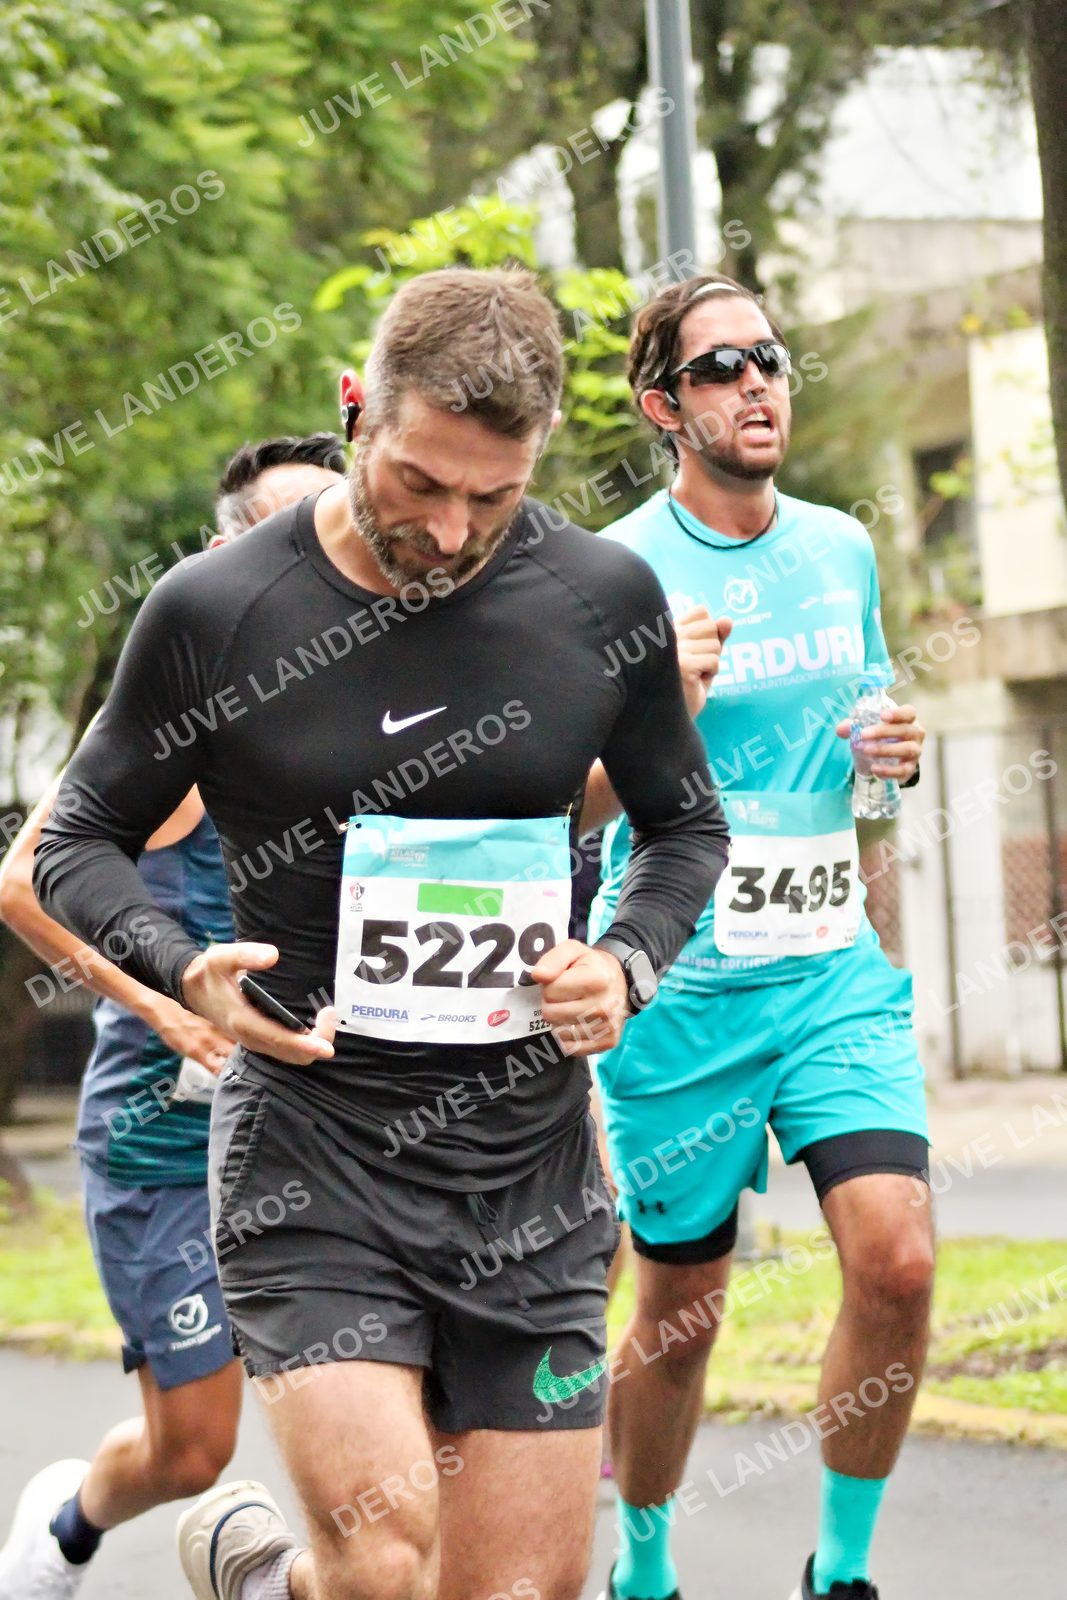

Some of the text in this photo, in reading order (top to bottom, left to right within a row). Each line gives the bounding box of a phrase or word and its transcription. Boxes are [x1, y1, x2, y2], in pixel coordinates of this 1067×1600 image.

[711, 623, 865, 687] ERDUR
[728, 860, 851, 914] 3495
[353, 919, 556, 989] 5229
[351, 1004, 409, 1020] PERDURA
[437, 1014, 478, 1023] BROOKS
